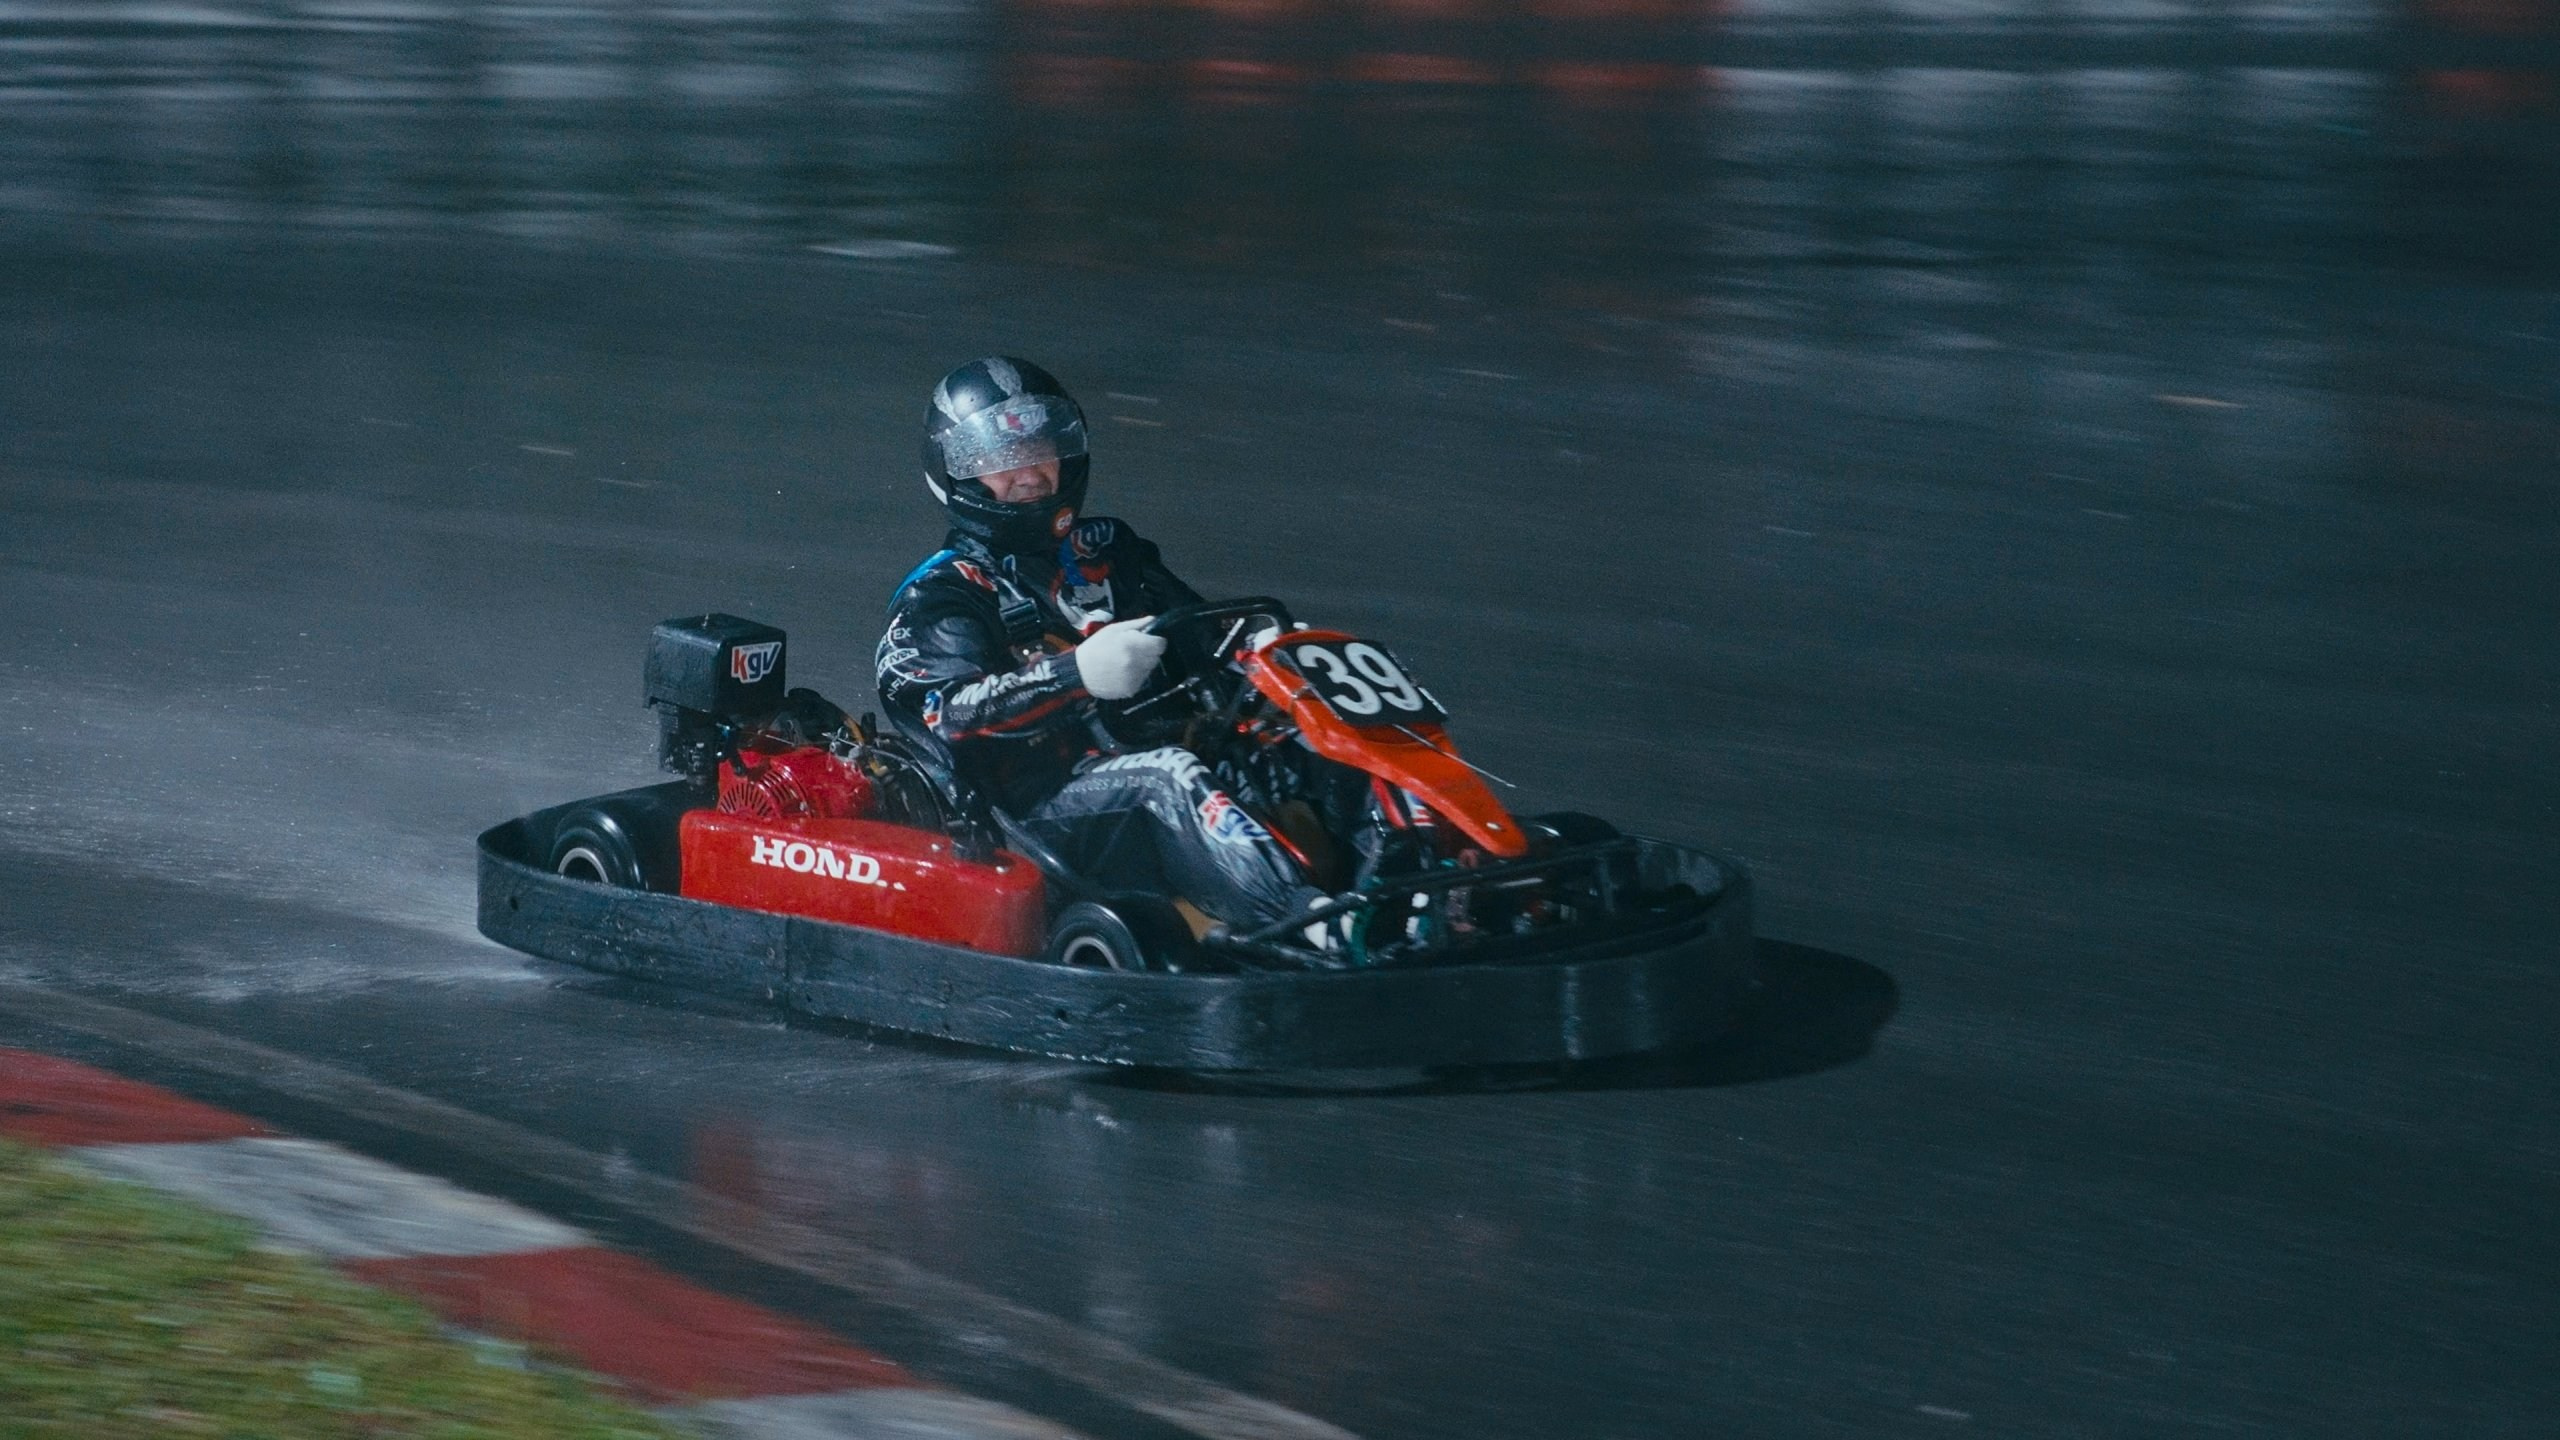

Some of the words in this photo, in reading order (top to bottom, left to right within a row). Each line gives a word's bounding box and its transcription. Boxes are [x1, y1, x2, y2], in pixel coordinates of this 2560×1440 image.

[733, 643, 781, 681] kgv
[1297, 643, 1424, 715] 39
[751, 835, 906, 891] HOND
